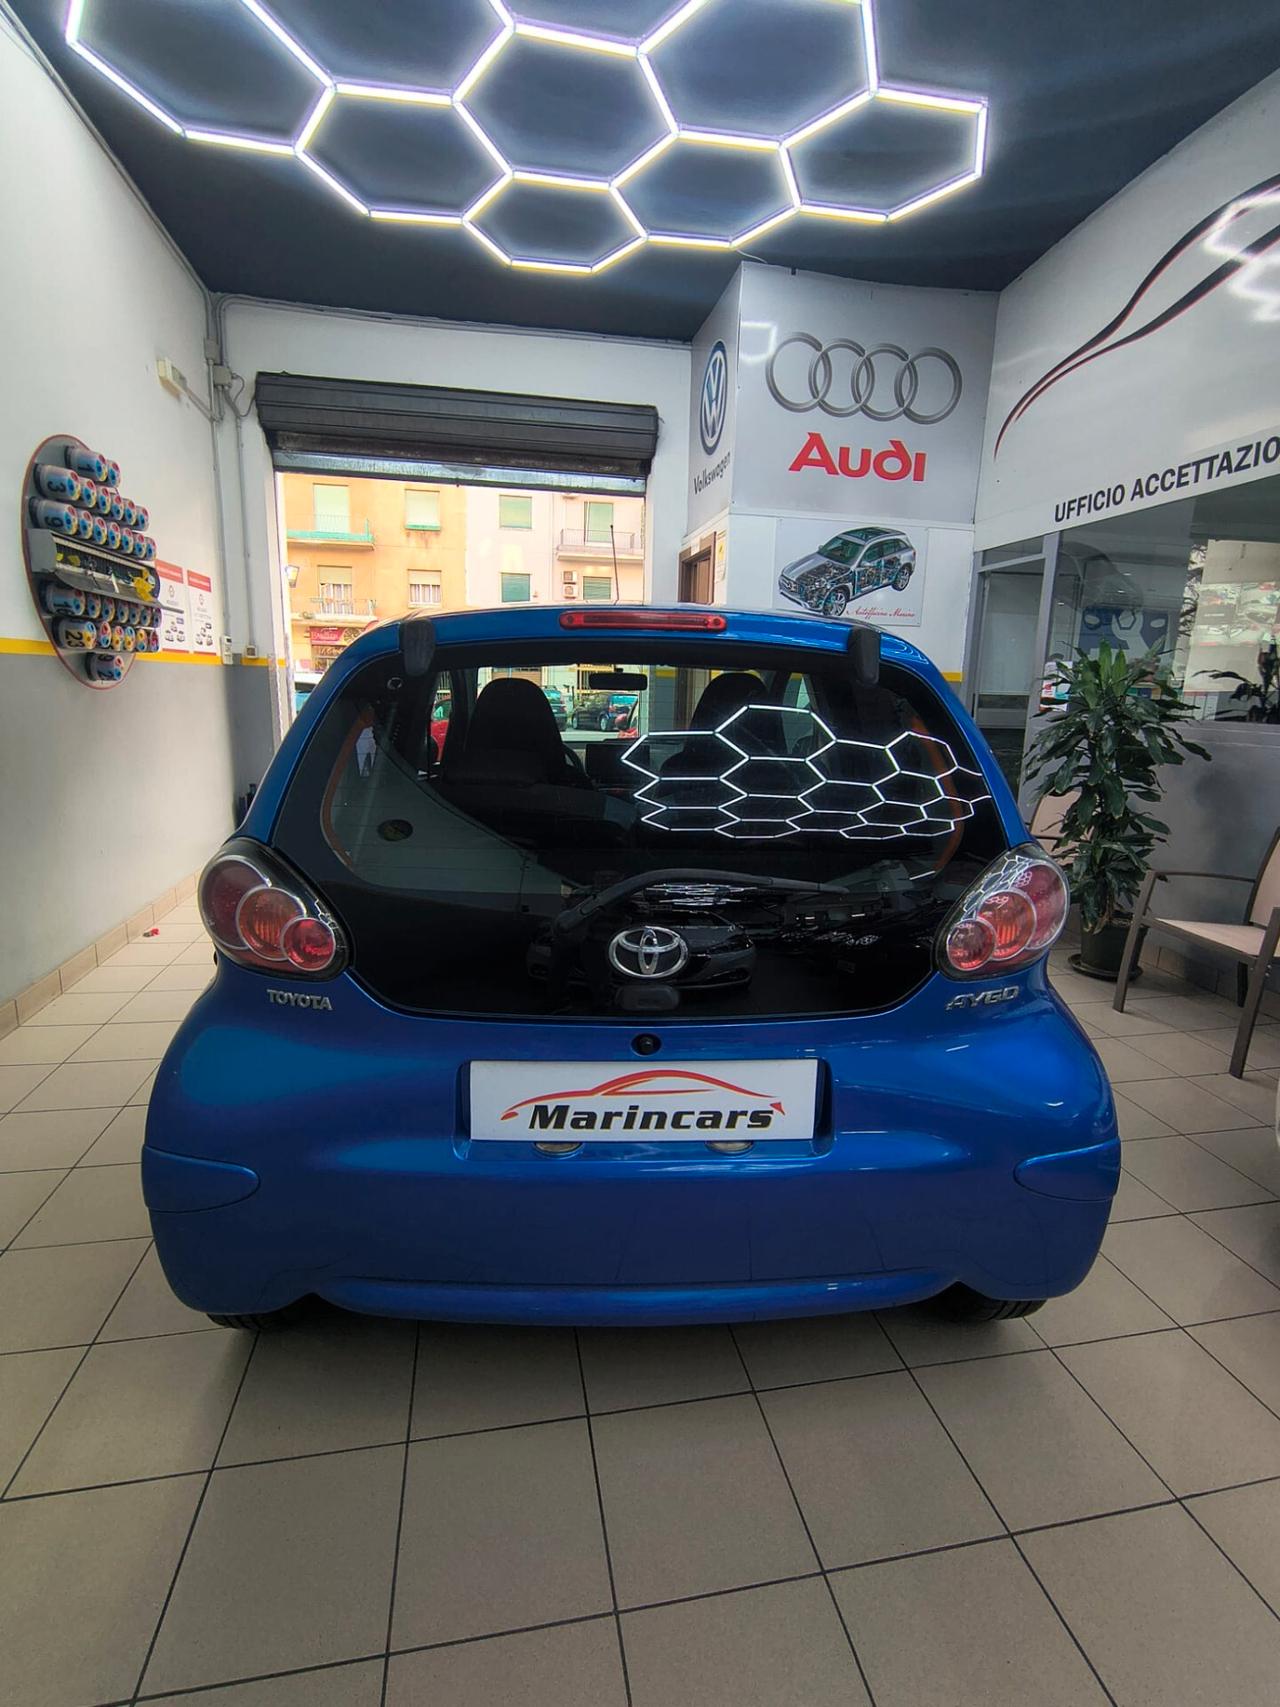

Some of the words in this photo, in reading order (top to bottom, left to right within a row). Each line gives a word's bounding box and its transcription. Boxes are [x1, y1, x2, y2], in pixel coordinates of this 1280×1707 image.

[693, 452, 731, 494] Volkswagen
[788, 432, 927, 482] Audi
[1054, 484, 1125, 523] UFFICIO
[1131, 436, 1280, 501] ACCETTAZIO
[266, 989, 333, 1011] TOYOTA
[945, 986, 1019, 1011] AYGO
[528, 1104, 774, 1131] Marincars
